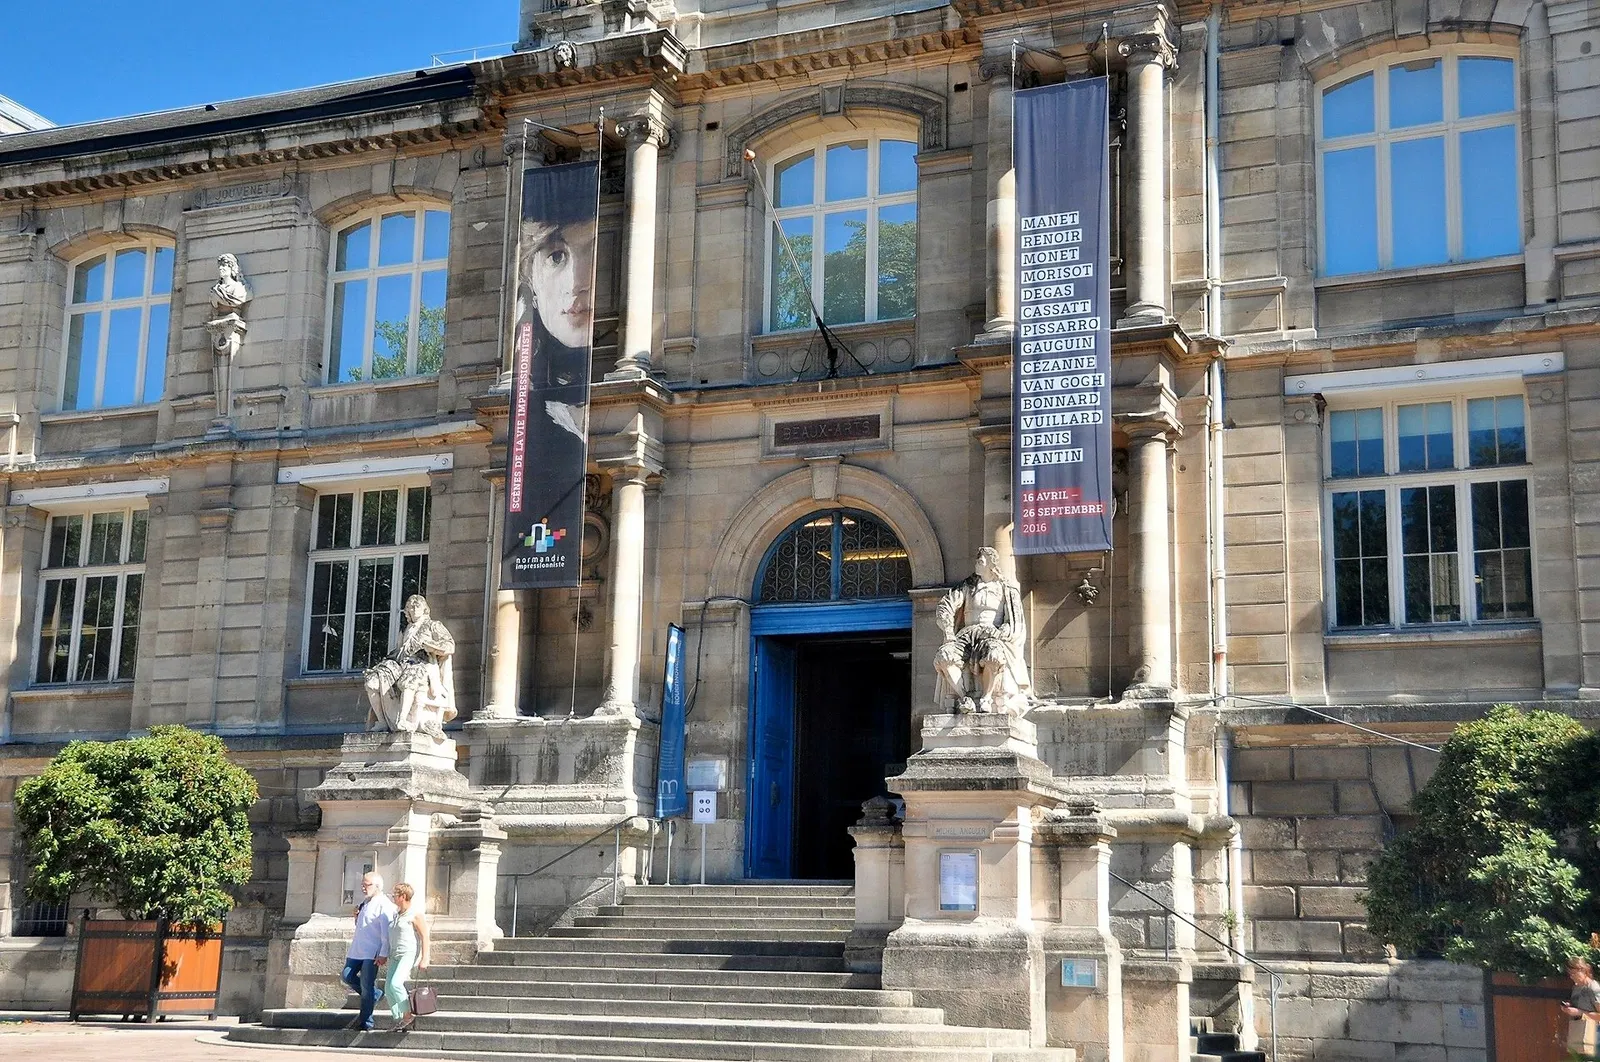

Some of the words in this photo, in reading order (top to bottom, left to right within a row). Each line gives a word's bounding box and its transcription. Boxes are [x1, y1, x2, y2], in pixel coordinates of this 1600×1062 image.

[215, 183, 271, 200] JOUVENET
[1023, 212, 1078, 230] MANET
[1023, 230, 1081, 248] RENOIR
[1023, 248, 1078, 265] MONET
[1023, 264, 1092, 283] MORISOT
[1023, 285, 1072, 301] DEGAS
[1023, 301, 1089, 318] CASSATT
[1023, 318, 1099, 336] PISSARRO
[1023, 337, 1093, 354] GAUGUIN
[518, 325, 531, 417] IMPRESSIONNISTE
[1023, 356, 1096, 374] CÉZANNE
[1023, 378, 1054, 392] VAN
[1060, 375, 1103, 388] GOGH
[1023, 393, 1099, 410] BONNARD
[517, 419, 525, 437] VIE
[1023, 412, 1102, 428] VUILLARD
[783, 420, 871, 440] BEAUX-ARTS
[516, 438, 524, 452] LA
[1023, 432, 1070, 447] DENIS
[515, 454, 523, 468] DE
[1023, 449, 1082, 465] FANTIN
[511, 471, 522, 509] SCÈNES
[1023, 493, 1034, 502] 16
[1036, 491, 1069, 501] AVRIL
[1023, 508, 1035, 518] 26
[1037, 504, 1103, 517] SEPTEMBRE
[1023, 523, 1047, 533] 2016
[515, 561, 565, 571] impressionniste
[516, 554, 566, 564] normandie
